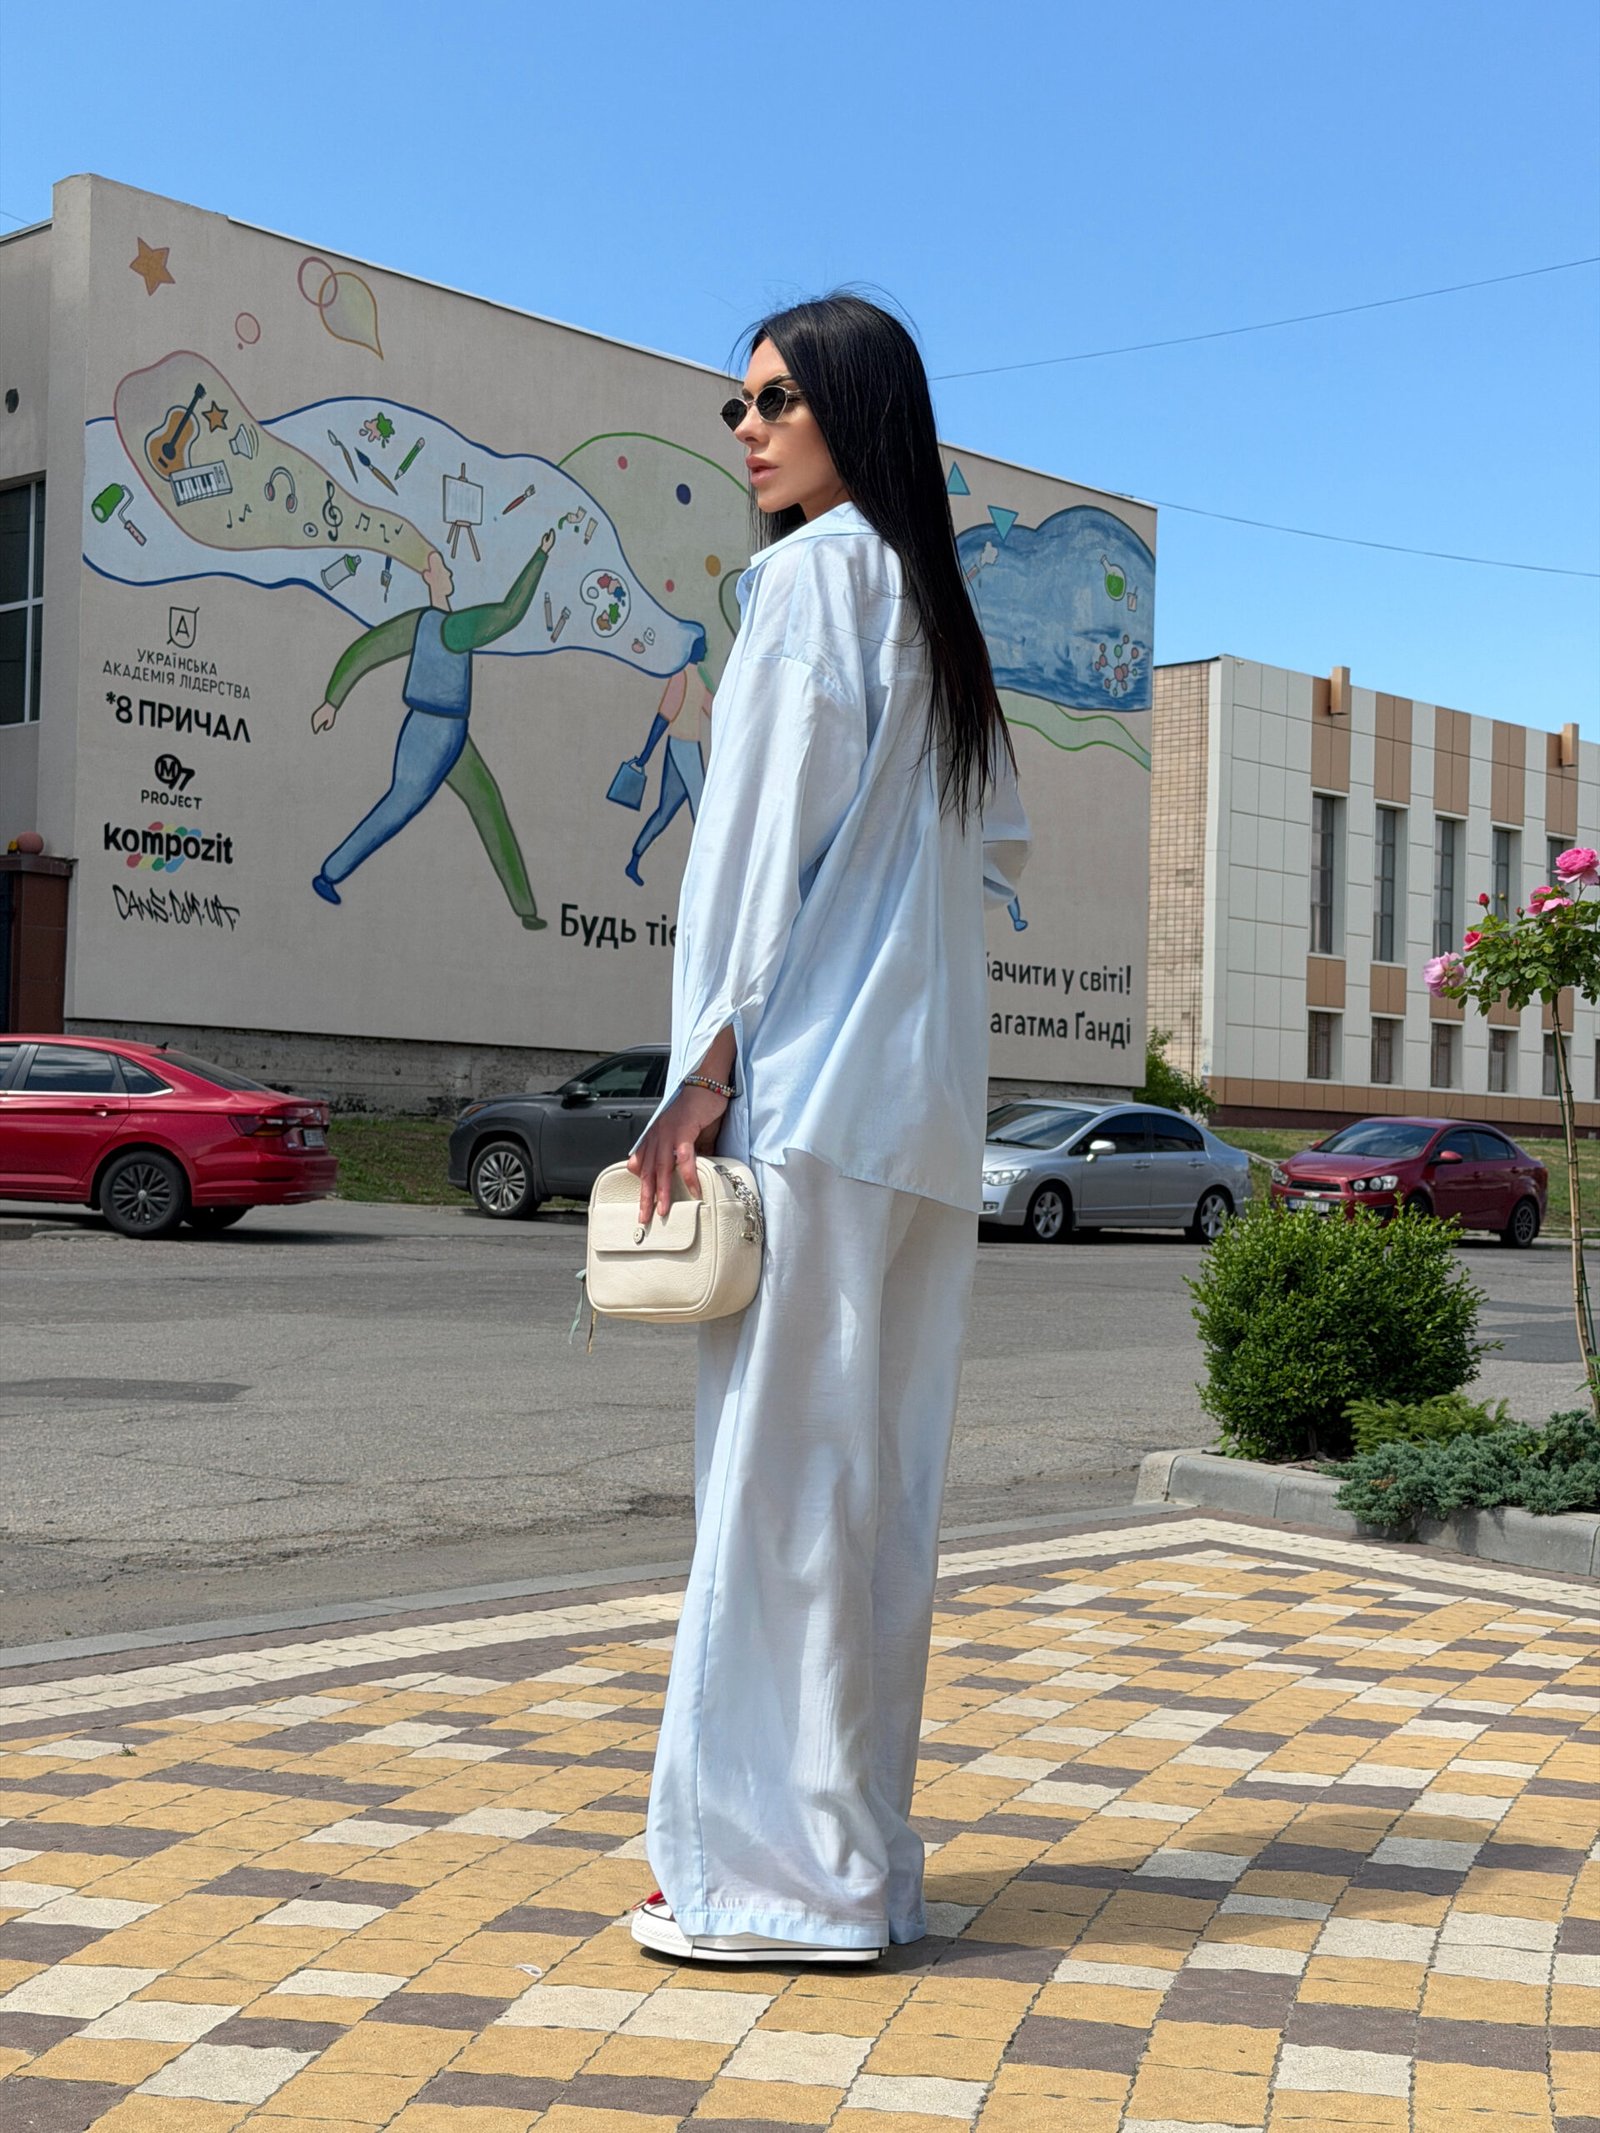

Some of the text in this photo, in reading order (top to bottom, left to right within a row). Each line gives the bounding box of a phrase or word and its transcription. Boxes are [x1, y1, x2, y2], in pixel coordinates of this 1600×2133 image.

[102, 660, 251, 700] АКАДЕМІЯ ЛІДЕРСТВА
[137, 648, 218, 676] УКРАЇНСЬКА
[139, 699, 251, 743] ПРИЧАЛ
[141, 789, 202, 810] PROJECT
[104, 822, 233, 864] kompozit
[561, 903, 678, 950] Будь тіє
[1062, 968, 1075, 995] у
[1080, 965, 1131, 995] світі!
[990, 1011, 1131, 1050] агатма Ґанді
